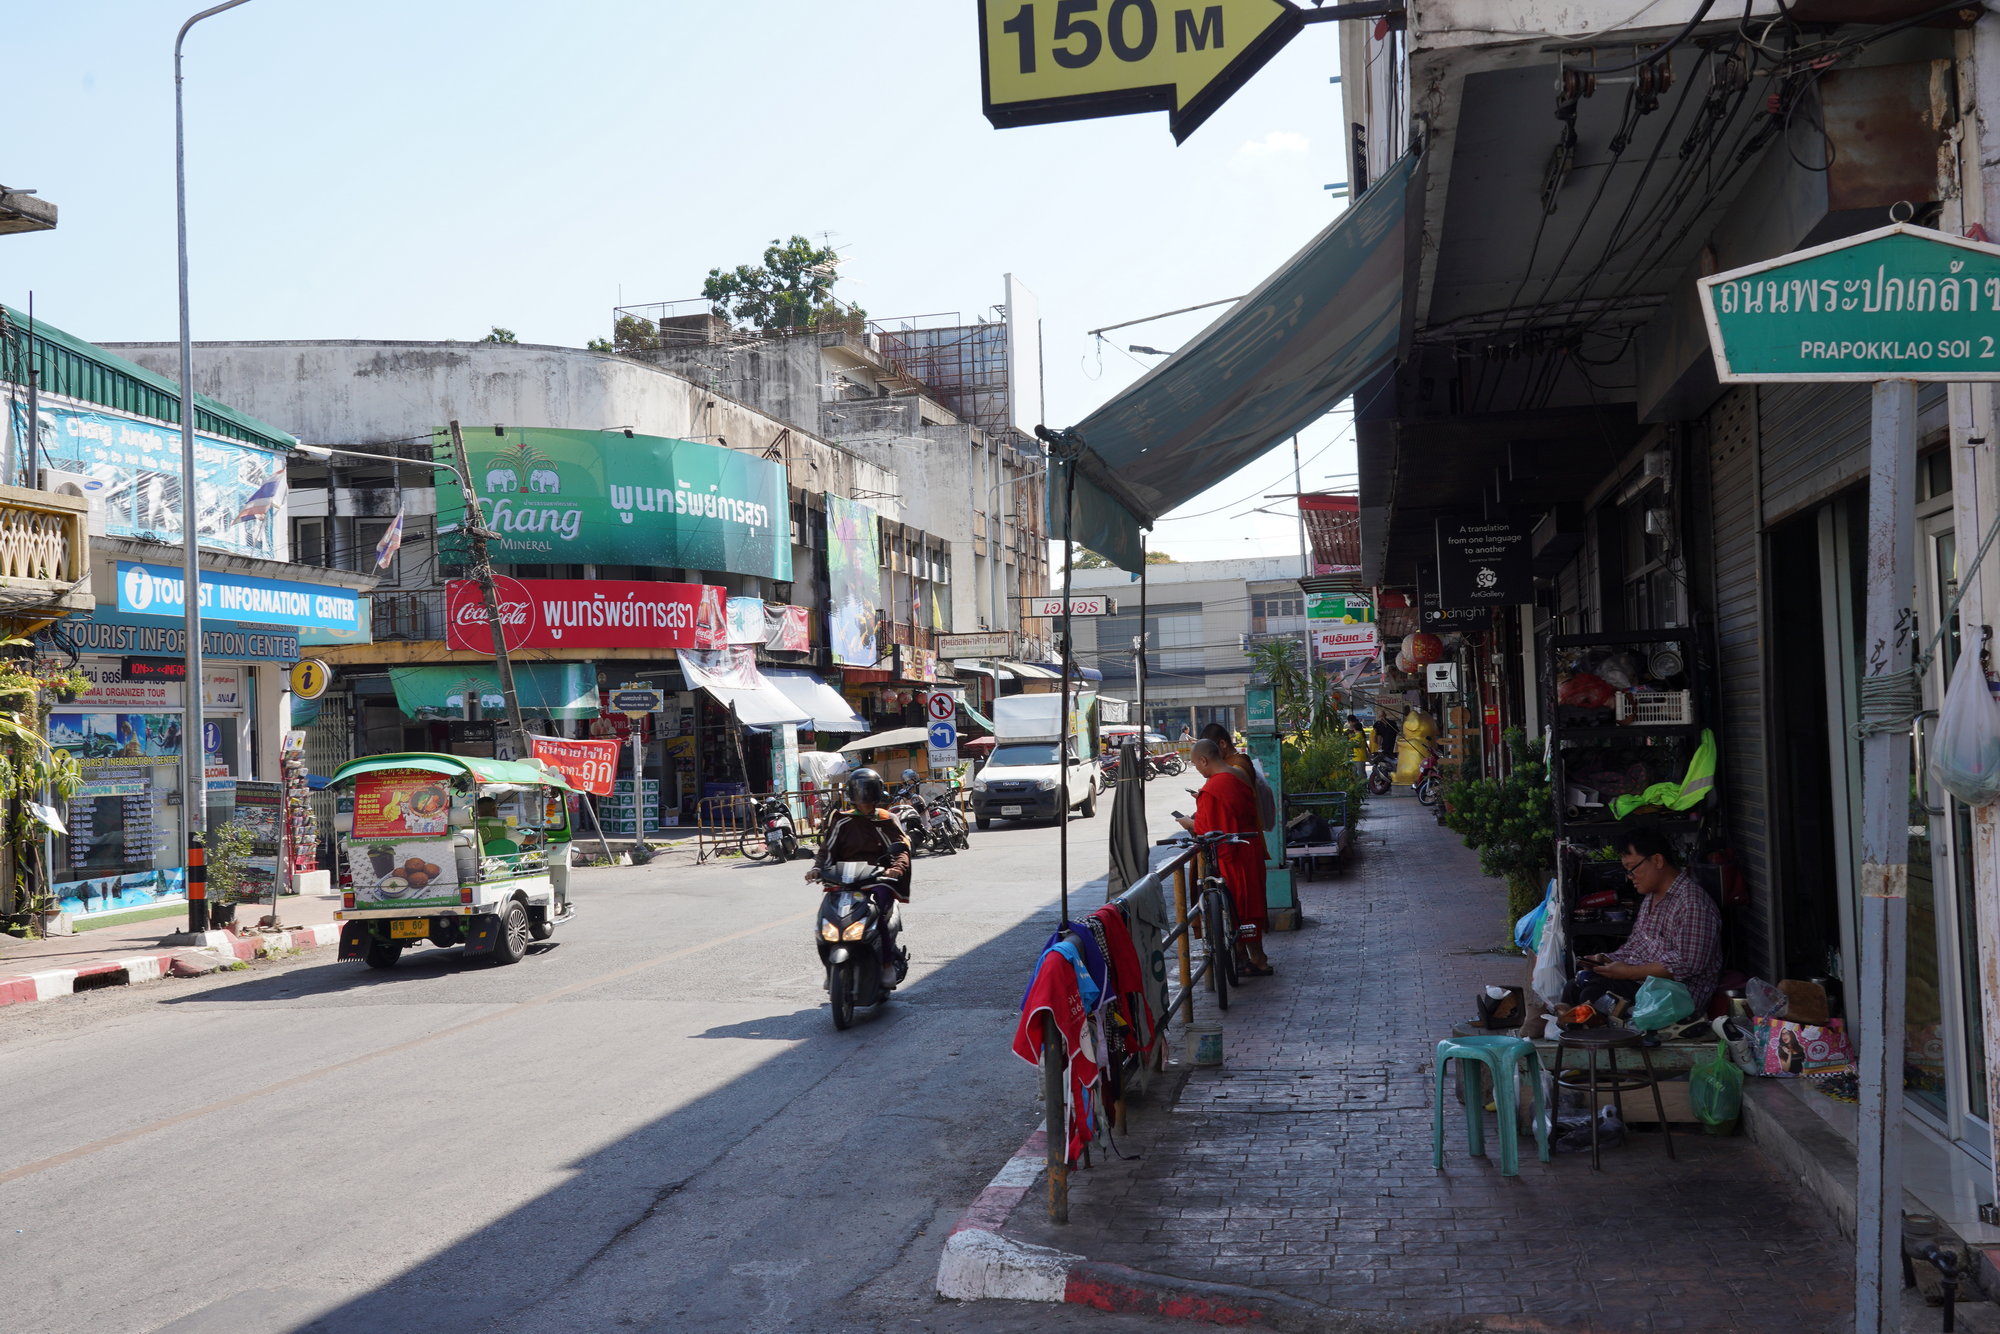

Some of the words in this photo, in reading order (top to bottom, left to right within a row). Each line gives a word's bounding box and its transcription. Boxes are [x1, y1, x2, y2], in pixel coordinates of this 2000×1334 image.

[1003, 0, 1158, 74] 150
[1174, 5, 1225, 53] M
[1801, 341, 1933, 359] PRAPOKKLAO
[1937, 340, 1970, 358] SOI
[1979, 336, 1995, 358] 2
[609, 479, 768, 537] พูนทรัพย์การสุรา
[1468, 524, 1510, 533] translation
[1448, 536, 1467, 545] from
[1469, 536, 1484, 544] one
[1485, 534, 1522, 546] language
[1464, 546, 1474, 554] to
[1475, 545, 1506, 554] another
[152, 577, 214, 607] TOUST
[220, 585, 310, 616] INFORMATION
[315, 596, 355, 621] CENTER
[543, 591, 693, 640] พูนทรัพย์การสุรา
[62, 622, 137, 649] TOURIST
[140, 627, 245, 655] INFORATION
[248, 634, 298, 658] CENTER
[105, 687, 145, 697] ORGANIZER
[147, 688, 166, 697] TOUR
[108, 756, 153, 767] INFORMATION
[156, 755, 180, 766] CENTER
[205, 768, 228, 778] ELCOME
